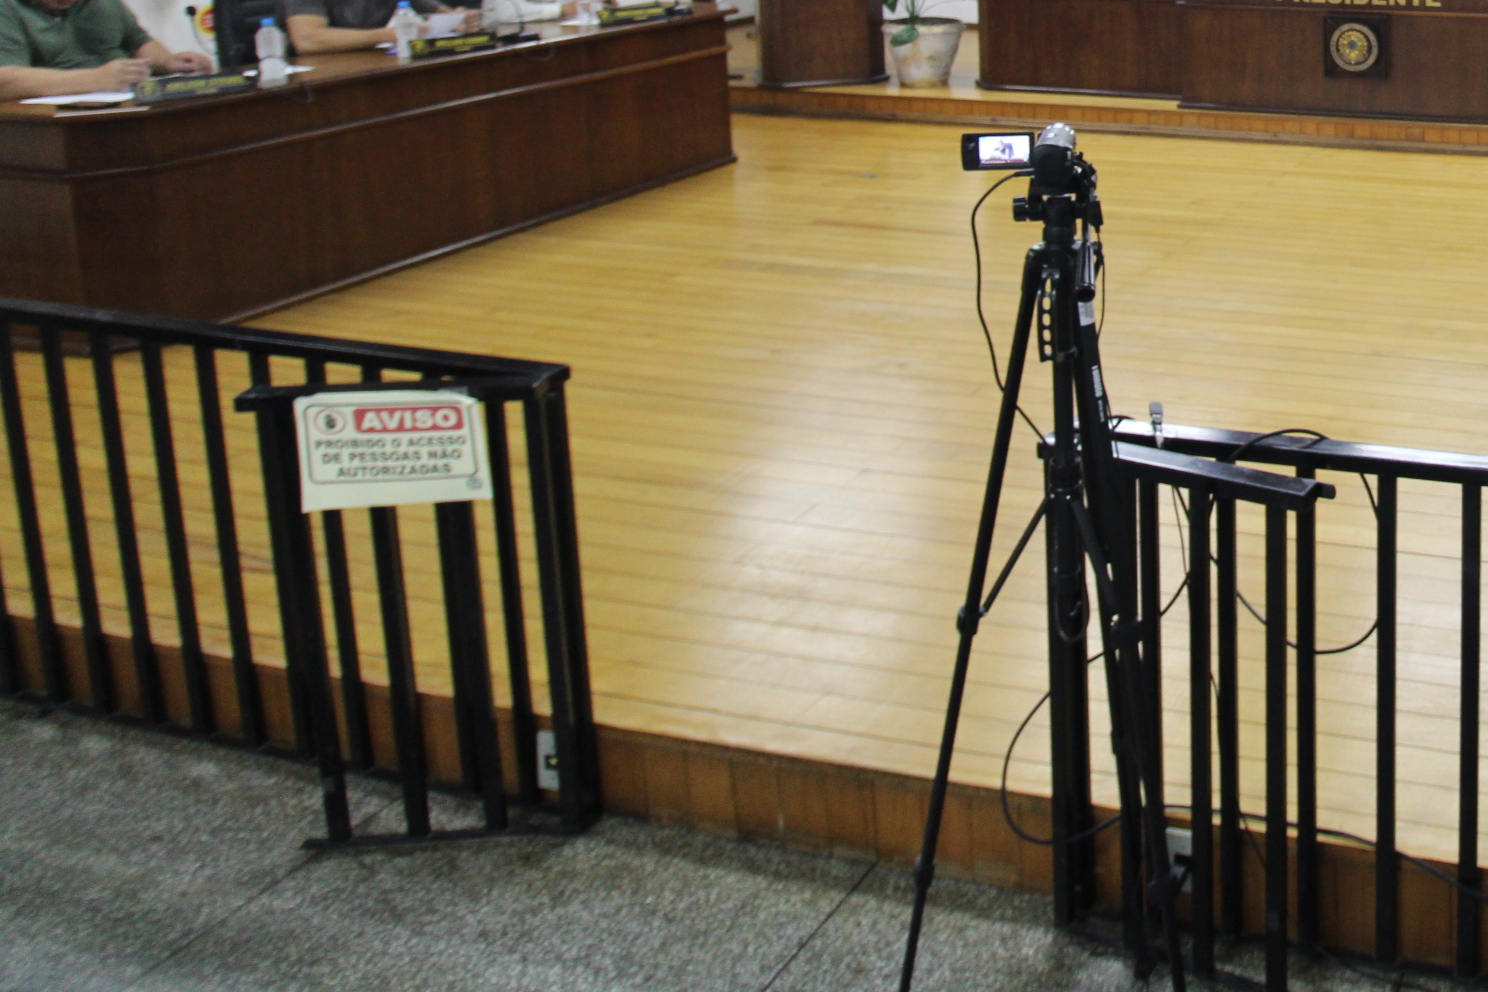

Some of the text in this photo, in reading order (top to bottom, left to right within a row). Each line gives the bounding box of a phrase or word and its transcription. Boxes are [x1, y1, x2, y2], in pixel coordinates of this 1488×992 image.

[360, 408, 459, 431] AVISO
[315, 435, 466, 450] PROIBIDO O ACESSO
[322, 448, 462, 464] DE PESSOAS NÃO
[337, 463, 452, 478] AUTORIZADAS
